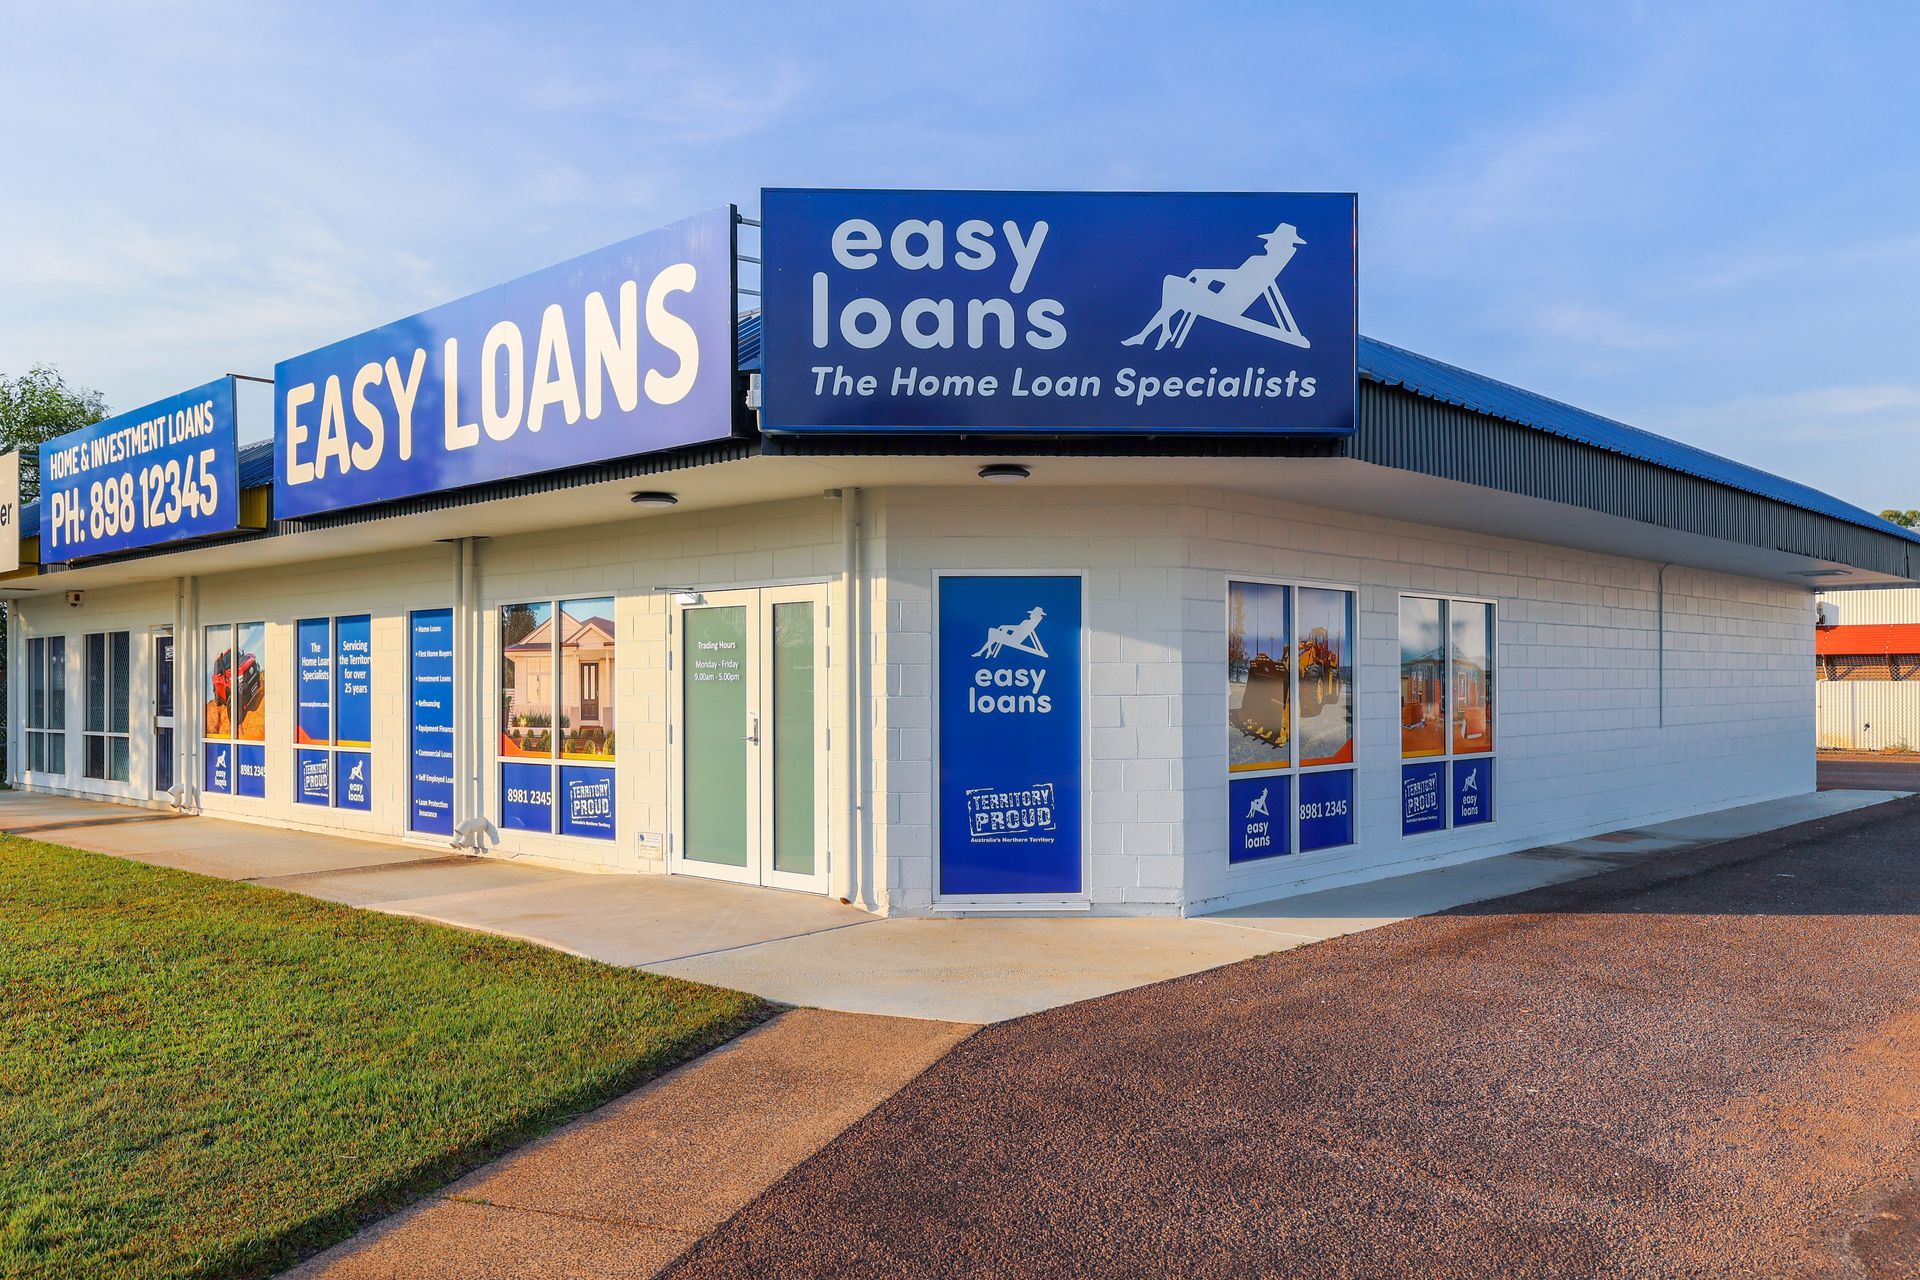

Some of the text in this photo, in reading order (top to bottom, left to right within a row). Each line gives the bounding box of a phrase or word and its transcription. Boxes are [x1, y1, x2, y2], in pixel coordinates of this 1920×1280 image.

[831, 219, 1049, 294] easy
[811, 272, 1067, 350] loans
[286, 262, 700, 486] EASY LOANS
[811, 366, 1317, 406] The Home Loan Specialists
[50, 399, 214, 481] HOME & INVESTMENT LOANS
[51, 448, 218, 548] PH: 898 12345
[310, 642, 321, 653] The
[342, 640, 368, 653] Servicing
[698, 641, 736, 651] Trading Hours
[301, 656, 317, 667] Home
[339, 654, 371, 665] the Territor
[695, 660, 717, 670] Monday
[721, 659, 739, 670] Friday
[344, 668, 367, 679] for over
[694, 672, 714, 681] 9.00am
[718, 672, 740, 683] 5.00pm
[974, 668, 1046, 694] easy
[344, 683, 368, 696] 25 years
[968, 687, 1052, 714] loans
[240, 764, 254, 776] 8981
[349, 783, 364, 795] easy
[572, 783, 609, 799] TERRITORY
[1406, 778, 1436, 797] TERRITORY
[348, 790, 365, 803] loans
[507, 788, 552, 806] 8981 2345
[972, 789, 1049, 811] TERRITORY
[1407, 792, 1437, 814] PROUD
[1462, 794, 1478, 807] easy
[573, 798, 610, 816] PROUD
[1299, 799, 1348, 820] 8981 2345
[1461, 804, 1479, 817] loans
[975, 807, 1052, 832] PROUD
[1246, 821, 1269, 836] easy
[1245, 834, 1271, 849] loans
